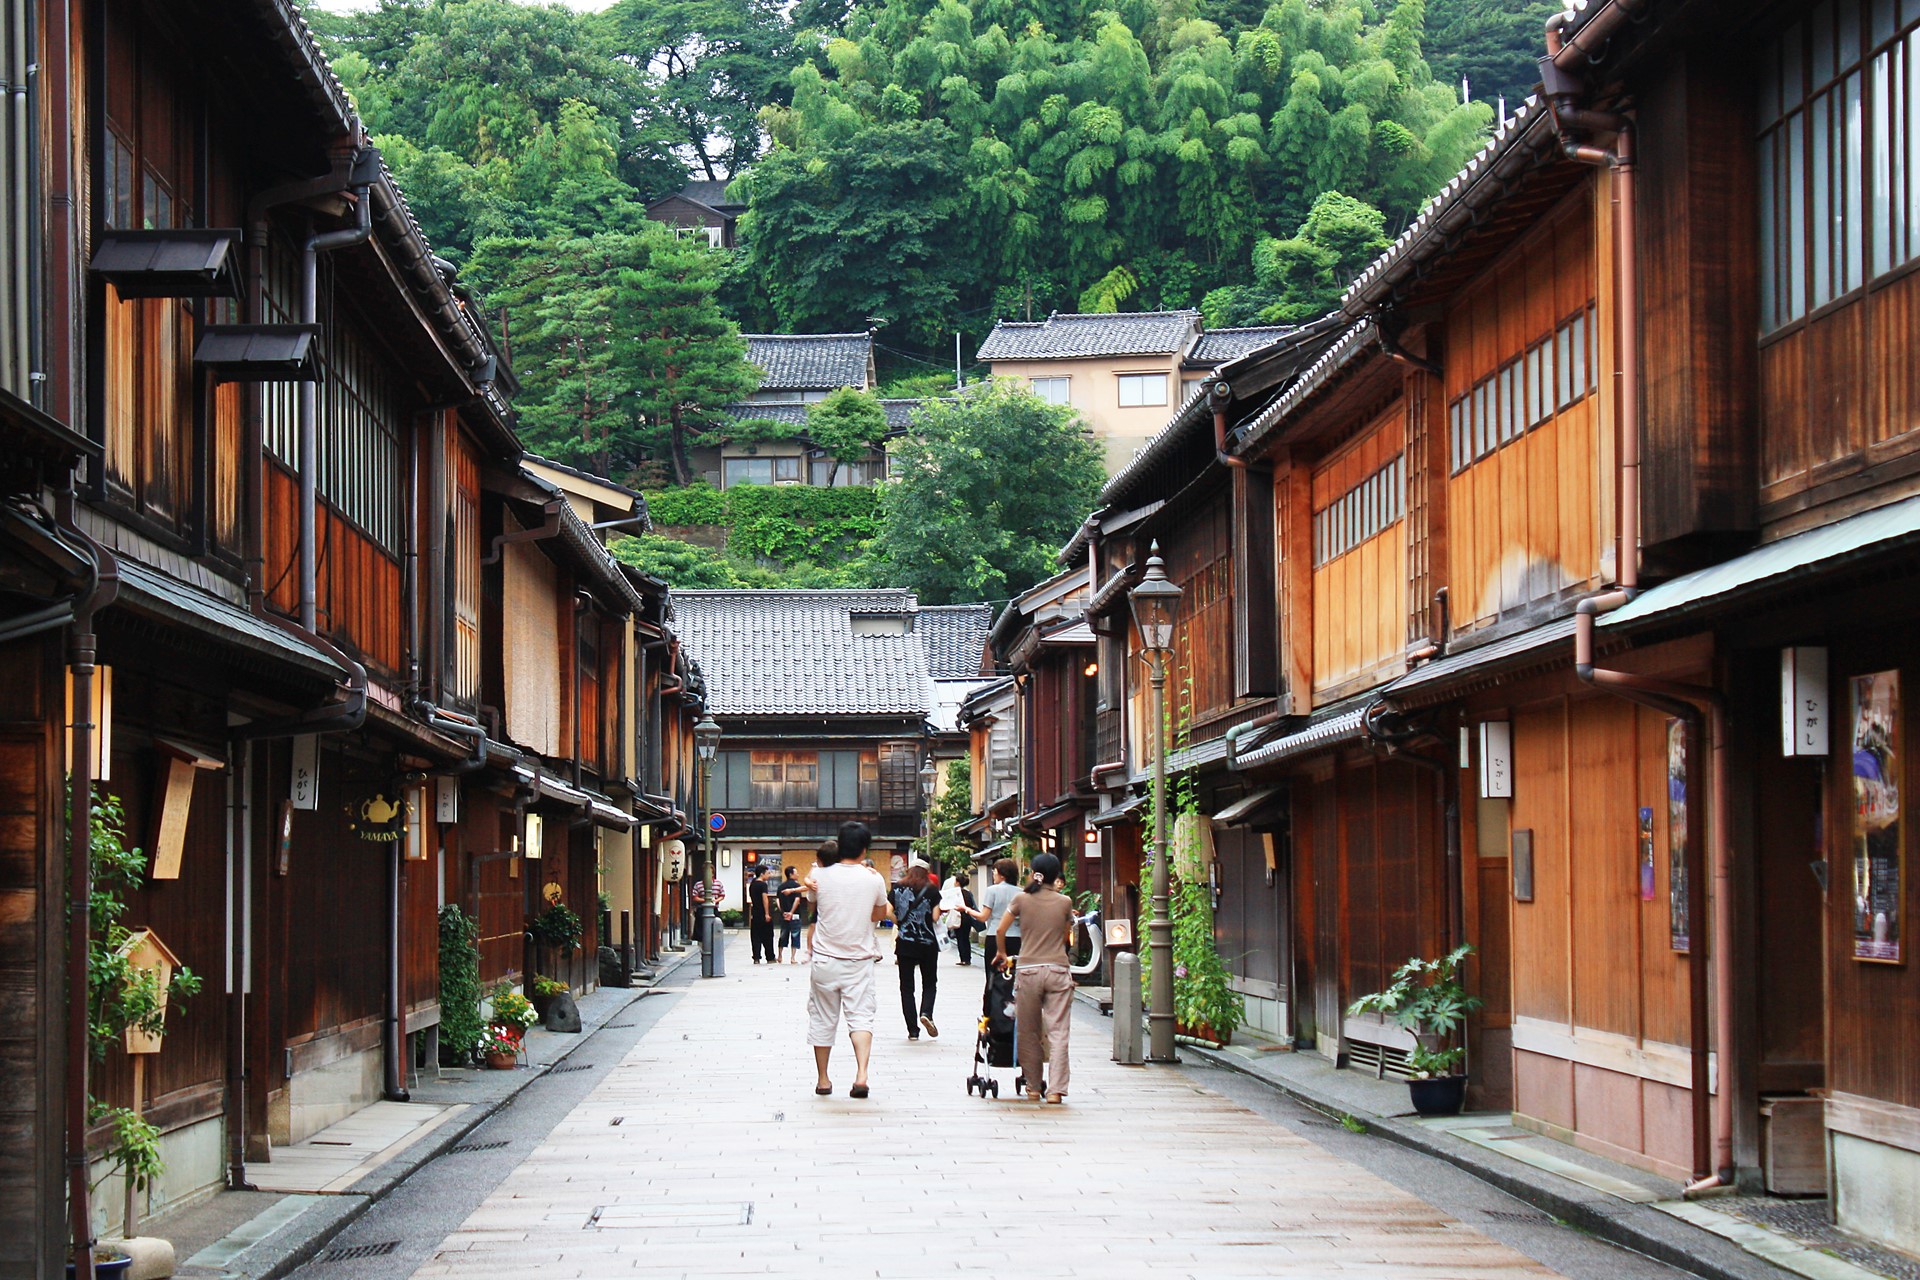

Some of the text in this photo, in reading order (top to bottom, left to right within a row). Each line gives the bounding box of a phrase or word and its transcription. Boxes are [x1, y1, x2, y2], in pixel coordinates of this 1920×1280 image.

[1805, 699, 1818, 746] ひがし
[296, 767, 308, 801] ひがし
[1495, 758, 1504, 791] ひがし
[360, 830, 399, 842] YAMAYA
